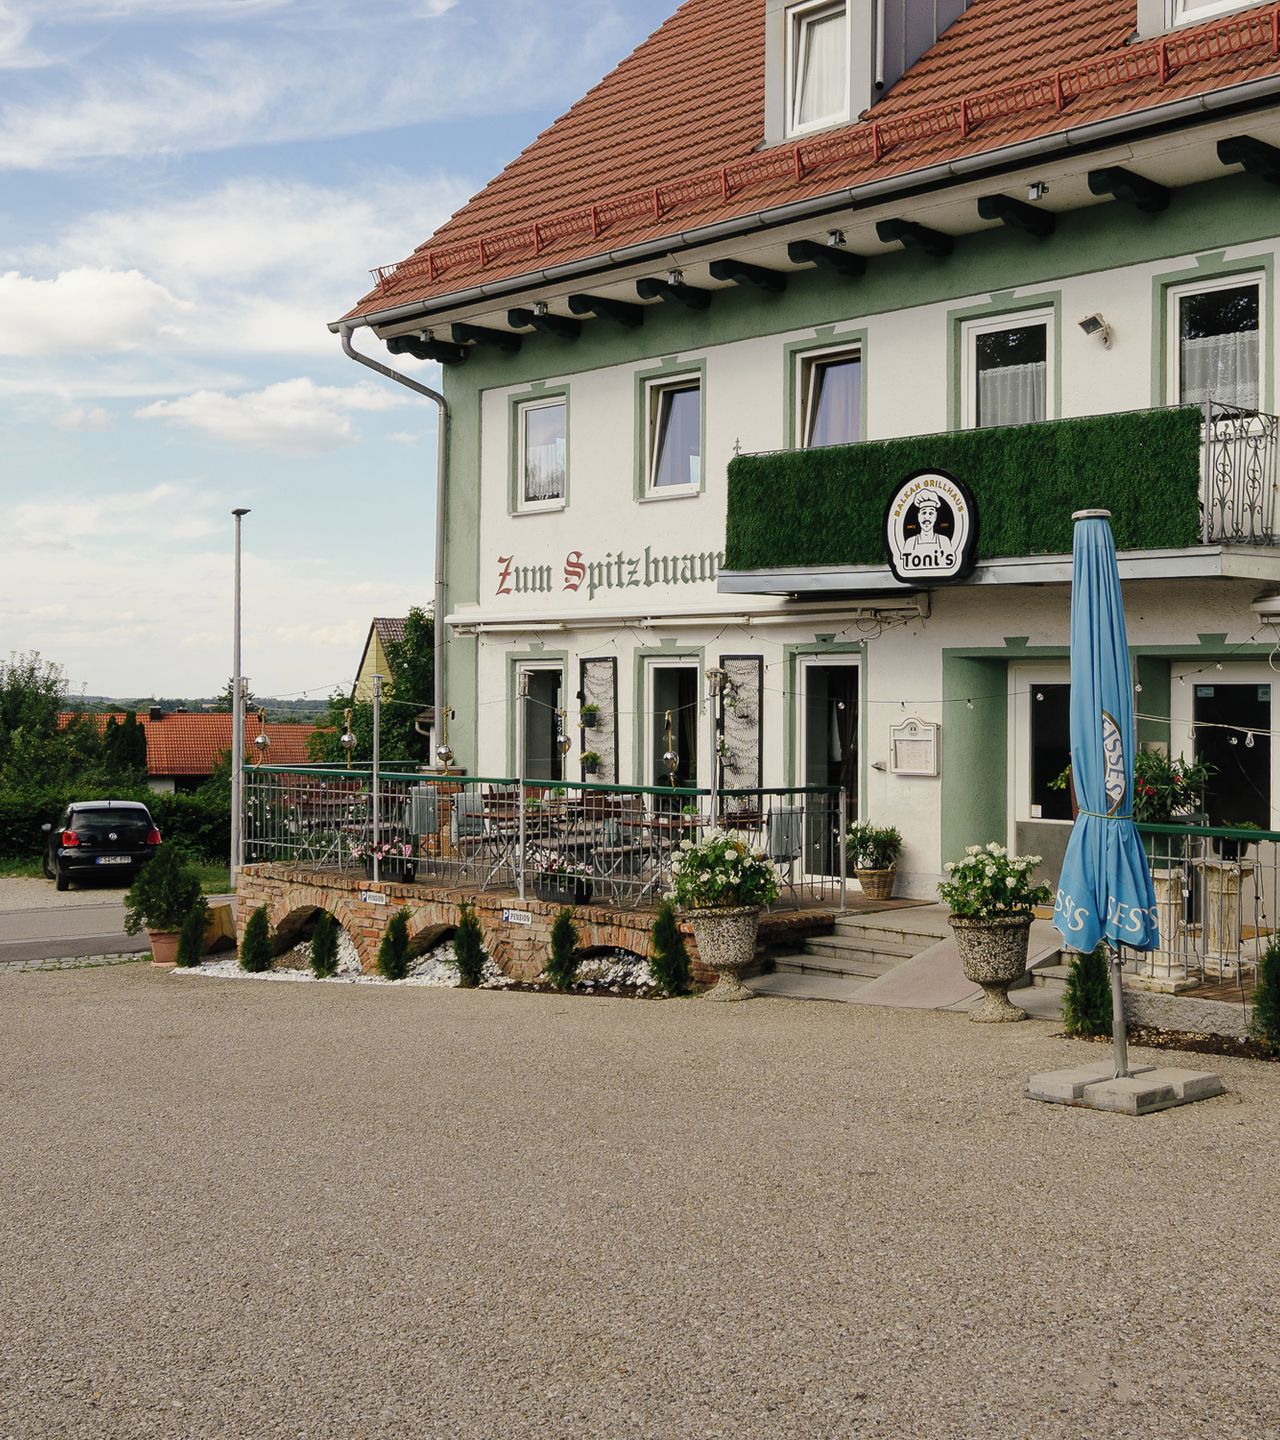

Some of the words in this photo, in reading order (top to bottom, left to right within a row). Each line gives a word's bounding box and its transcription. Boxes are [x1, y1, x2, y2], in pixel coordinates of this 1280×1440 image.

[894, 483, 921, 517] BALKAN
[923, 479, 964, 513] GRILLHAUS
[902, 549, 955, 568] Toni's
[495, 554, 553, 596] Zum
[361, 891, 367, 902] P
[502, 909, 509, 921] P
[510, 912, 531, 923] PENSION
